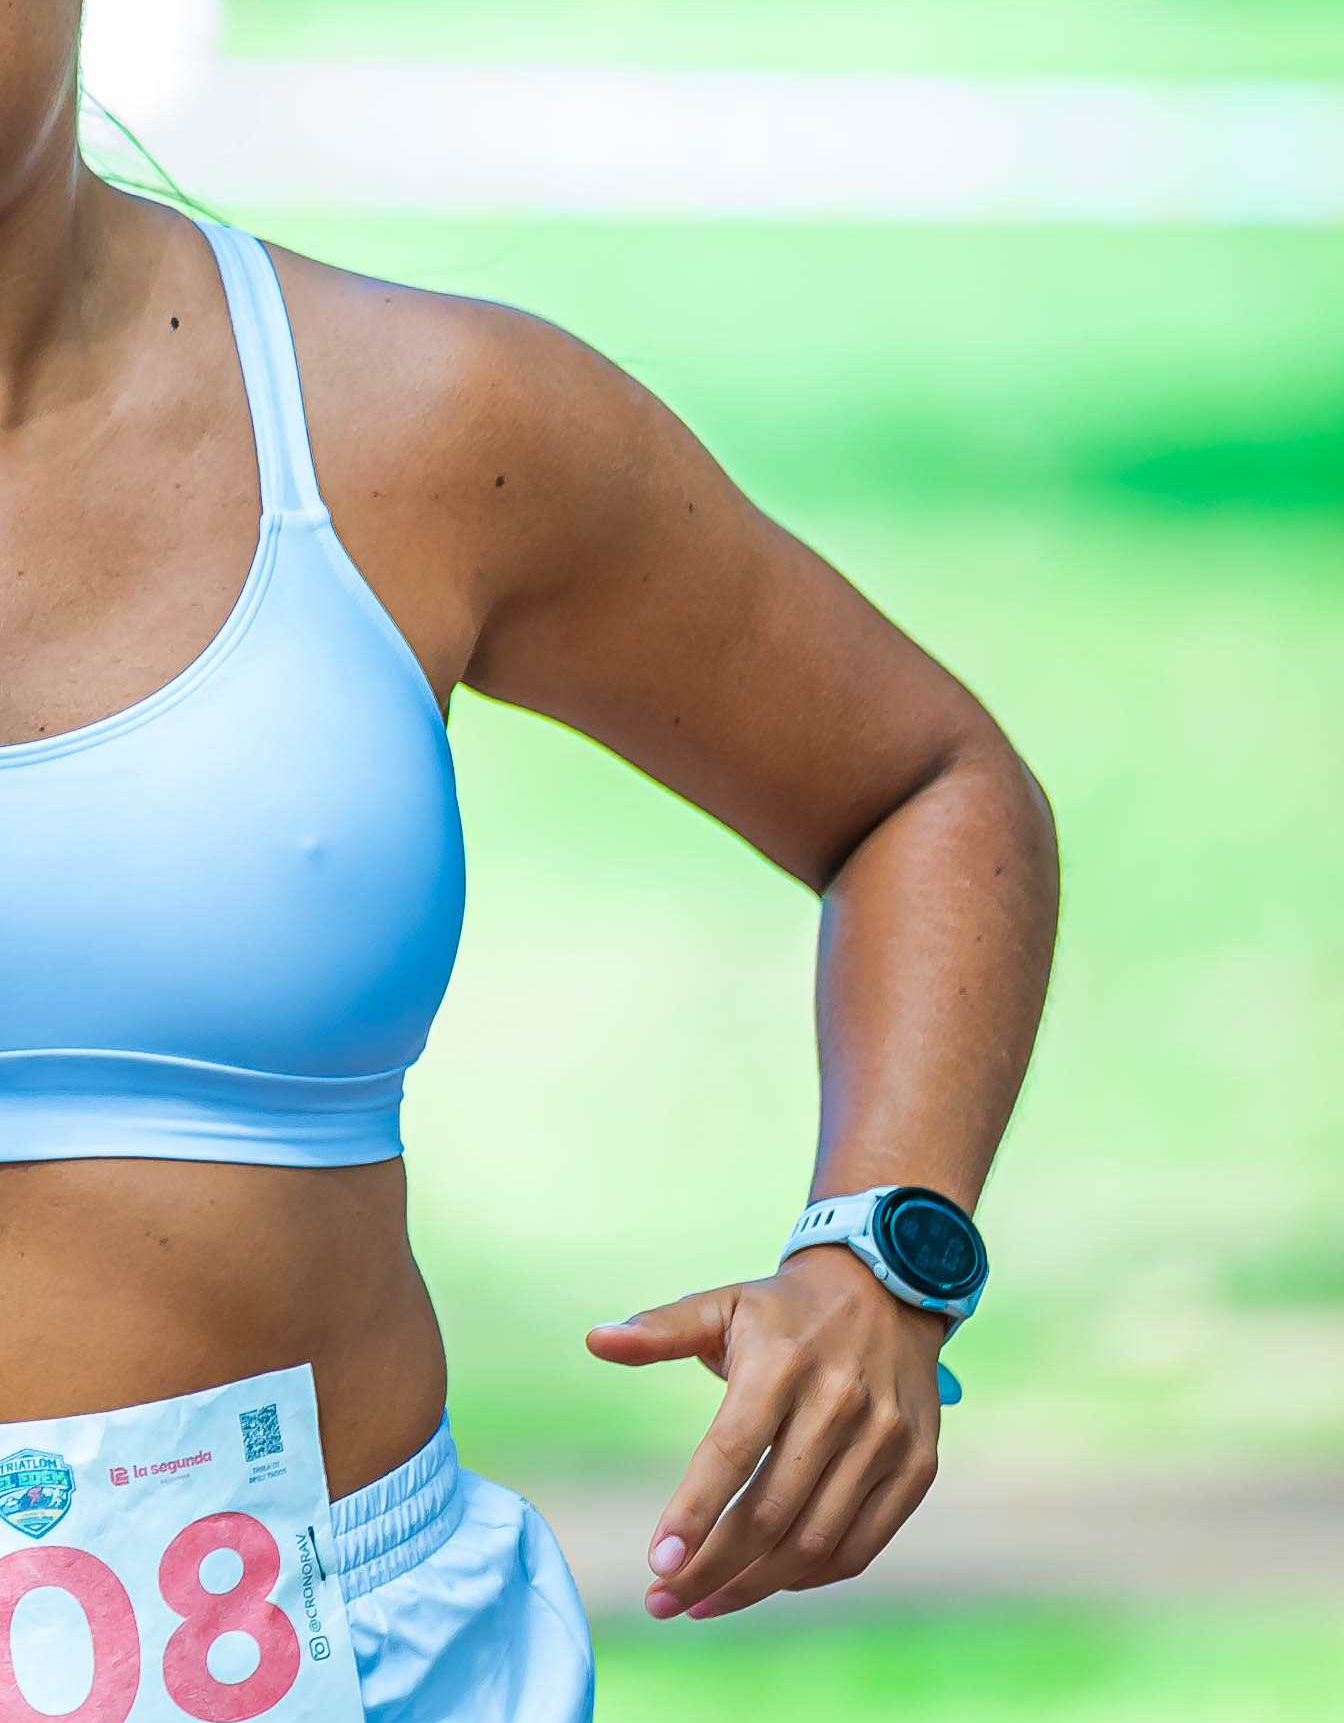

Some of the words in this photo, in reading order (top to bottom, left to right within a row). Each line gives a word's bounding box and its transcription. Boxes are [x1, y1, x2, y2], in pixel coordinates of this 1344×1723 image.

[133, 1465, 148, 1479] la
[150, 1450, 213, 1475] segunda
[296, 1533, 322, 1633] @CRONORAV
